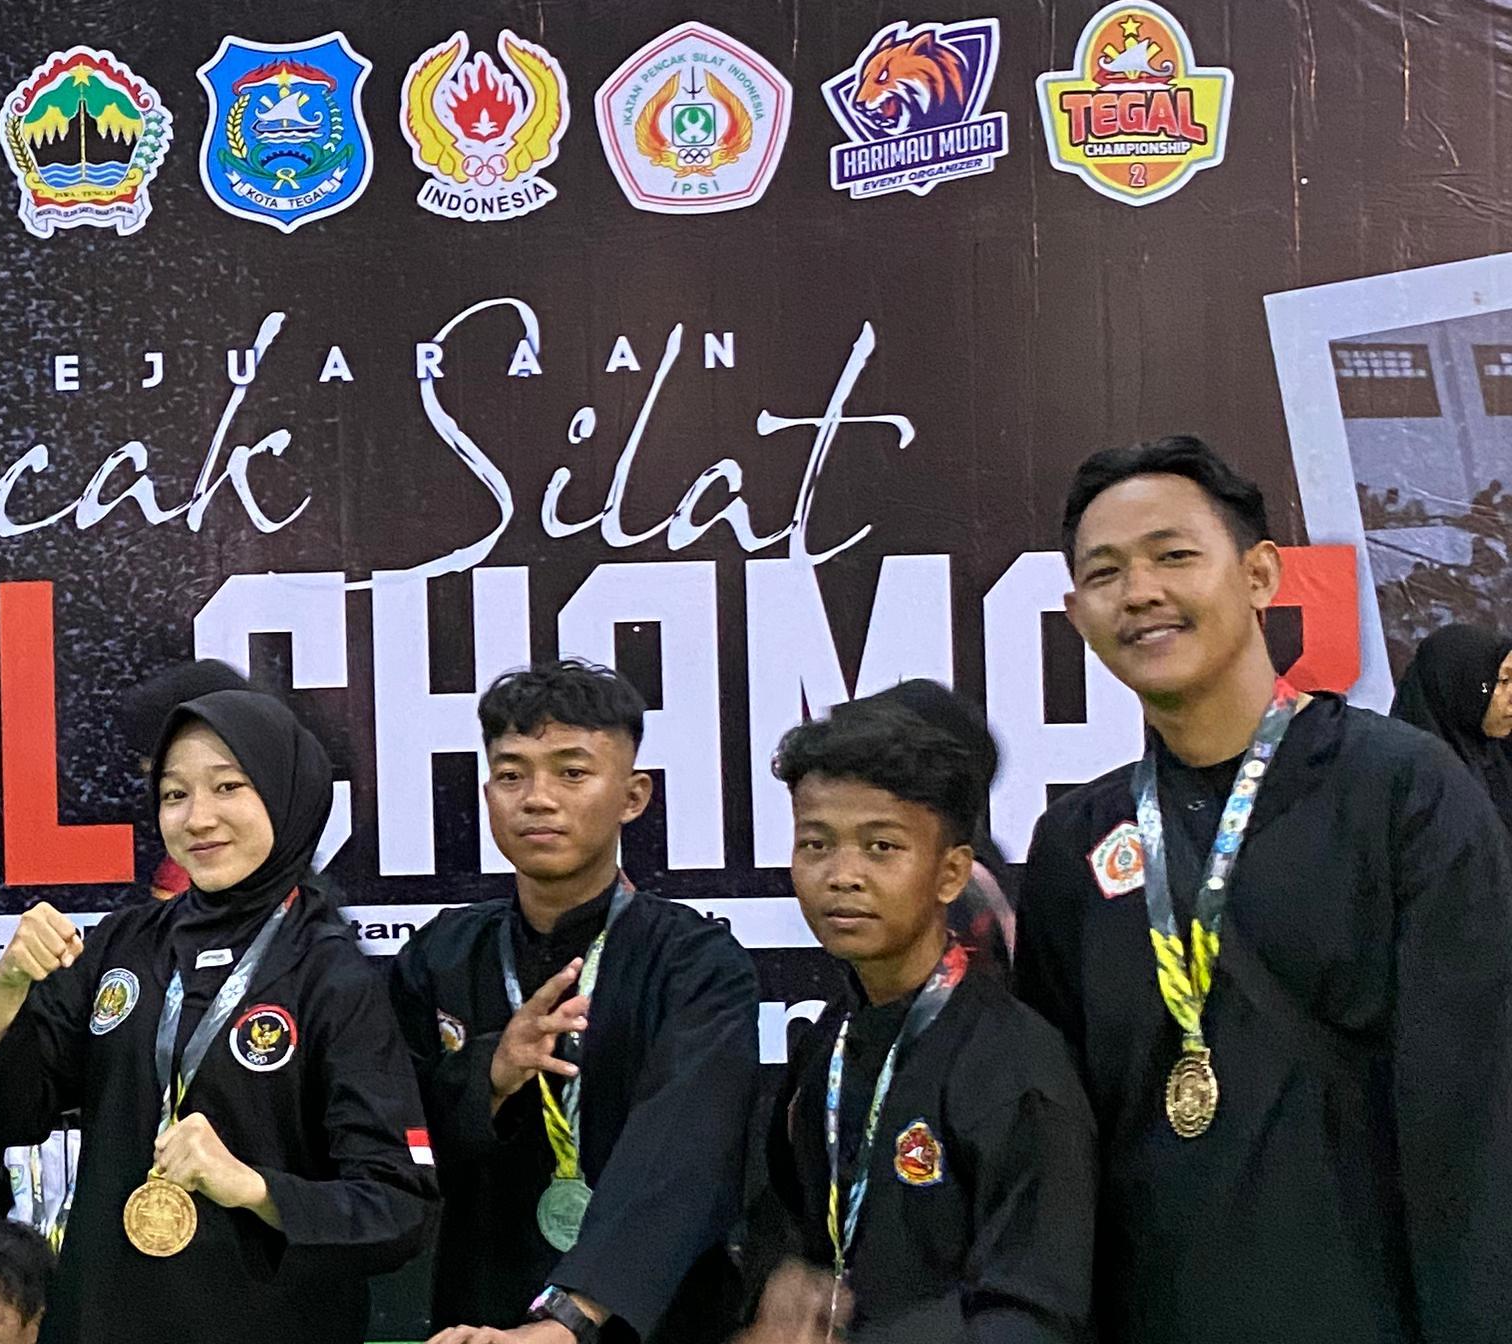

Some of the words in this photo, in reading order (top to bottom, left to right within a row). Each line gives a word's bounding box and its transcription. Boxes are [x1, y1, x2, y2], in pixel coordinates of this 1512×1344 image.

[623, 85, 643, 126] IKATAN
[641, 54, 687, 83] PENCAK
[692, 52, 726, 67] SILAT
[728, 64, 766, 121] INDONESIA
[1061, 89, 1207, 145] TEGAL
[843, 134, 934, 178] HARIMAU
[938, 122, 997, 158] MUDA
[1085, 141, 1192, 157] CHAMPIONSHIP
[862, 174, 905, 191] EVENT
[908, 159, 983, 181] ORGANIZER
[1129, 163, 1147, 187] 2
[246, 188, 278, 208] KOTA
[288, 187, 328, 208] TEGAL
[424, 183, 548, 214] INDONESIA
[268, 297, 915, 591] Silat
